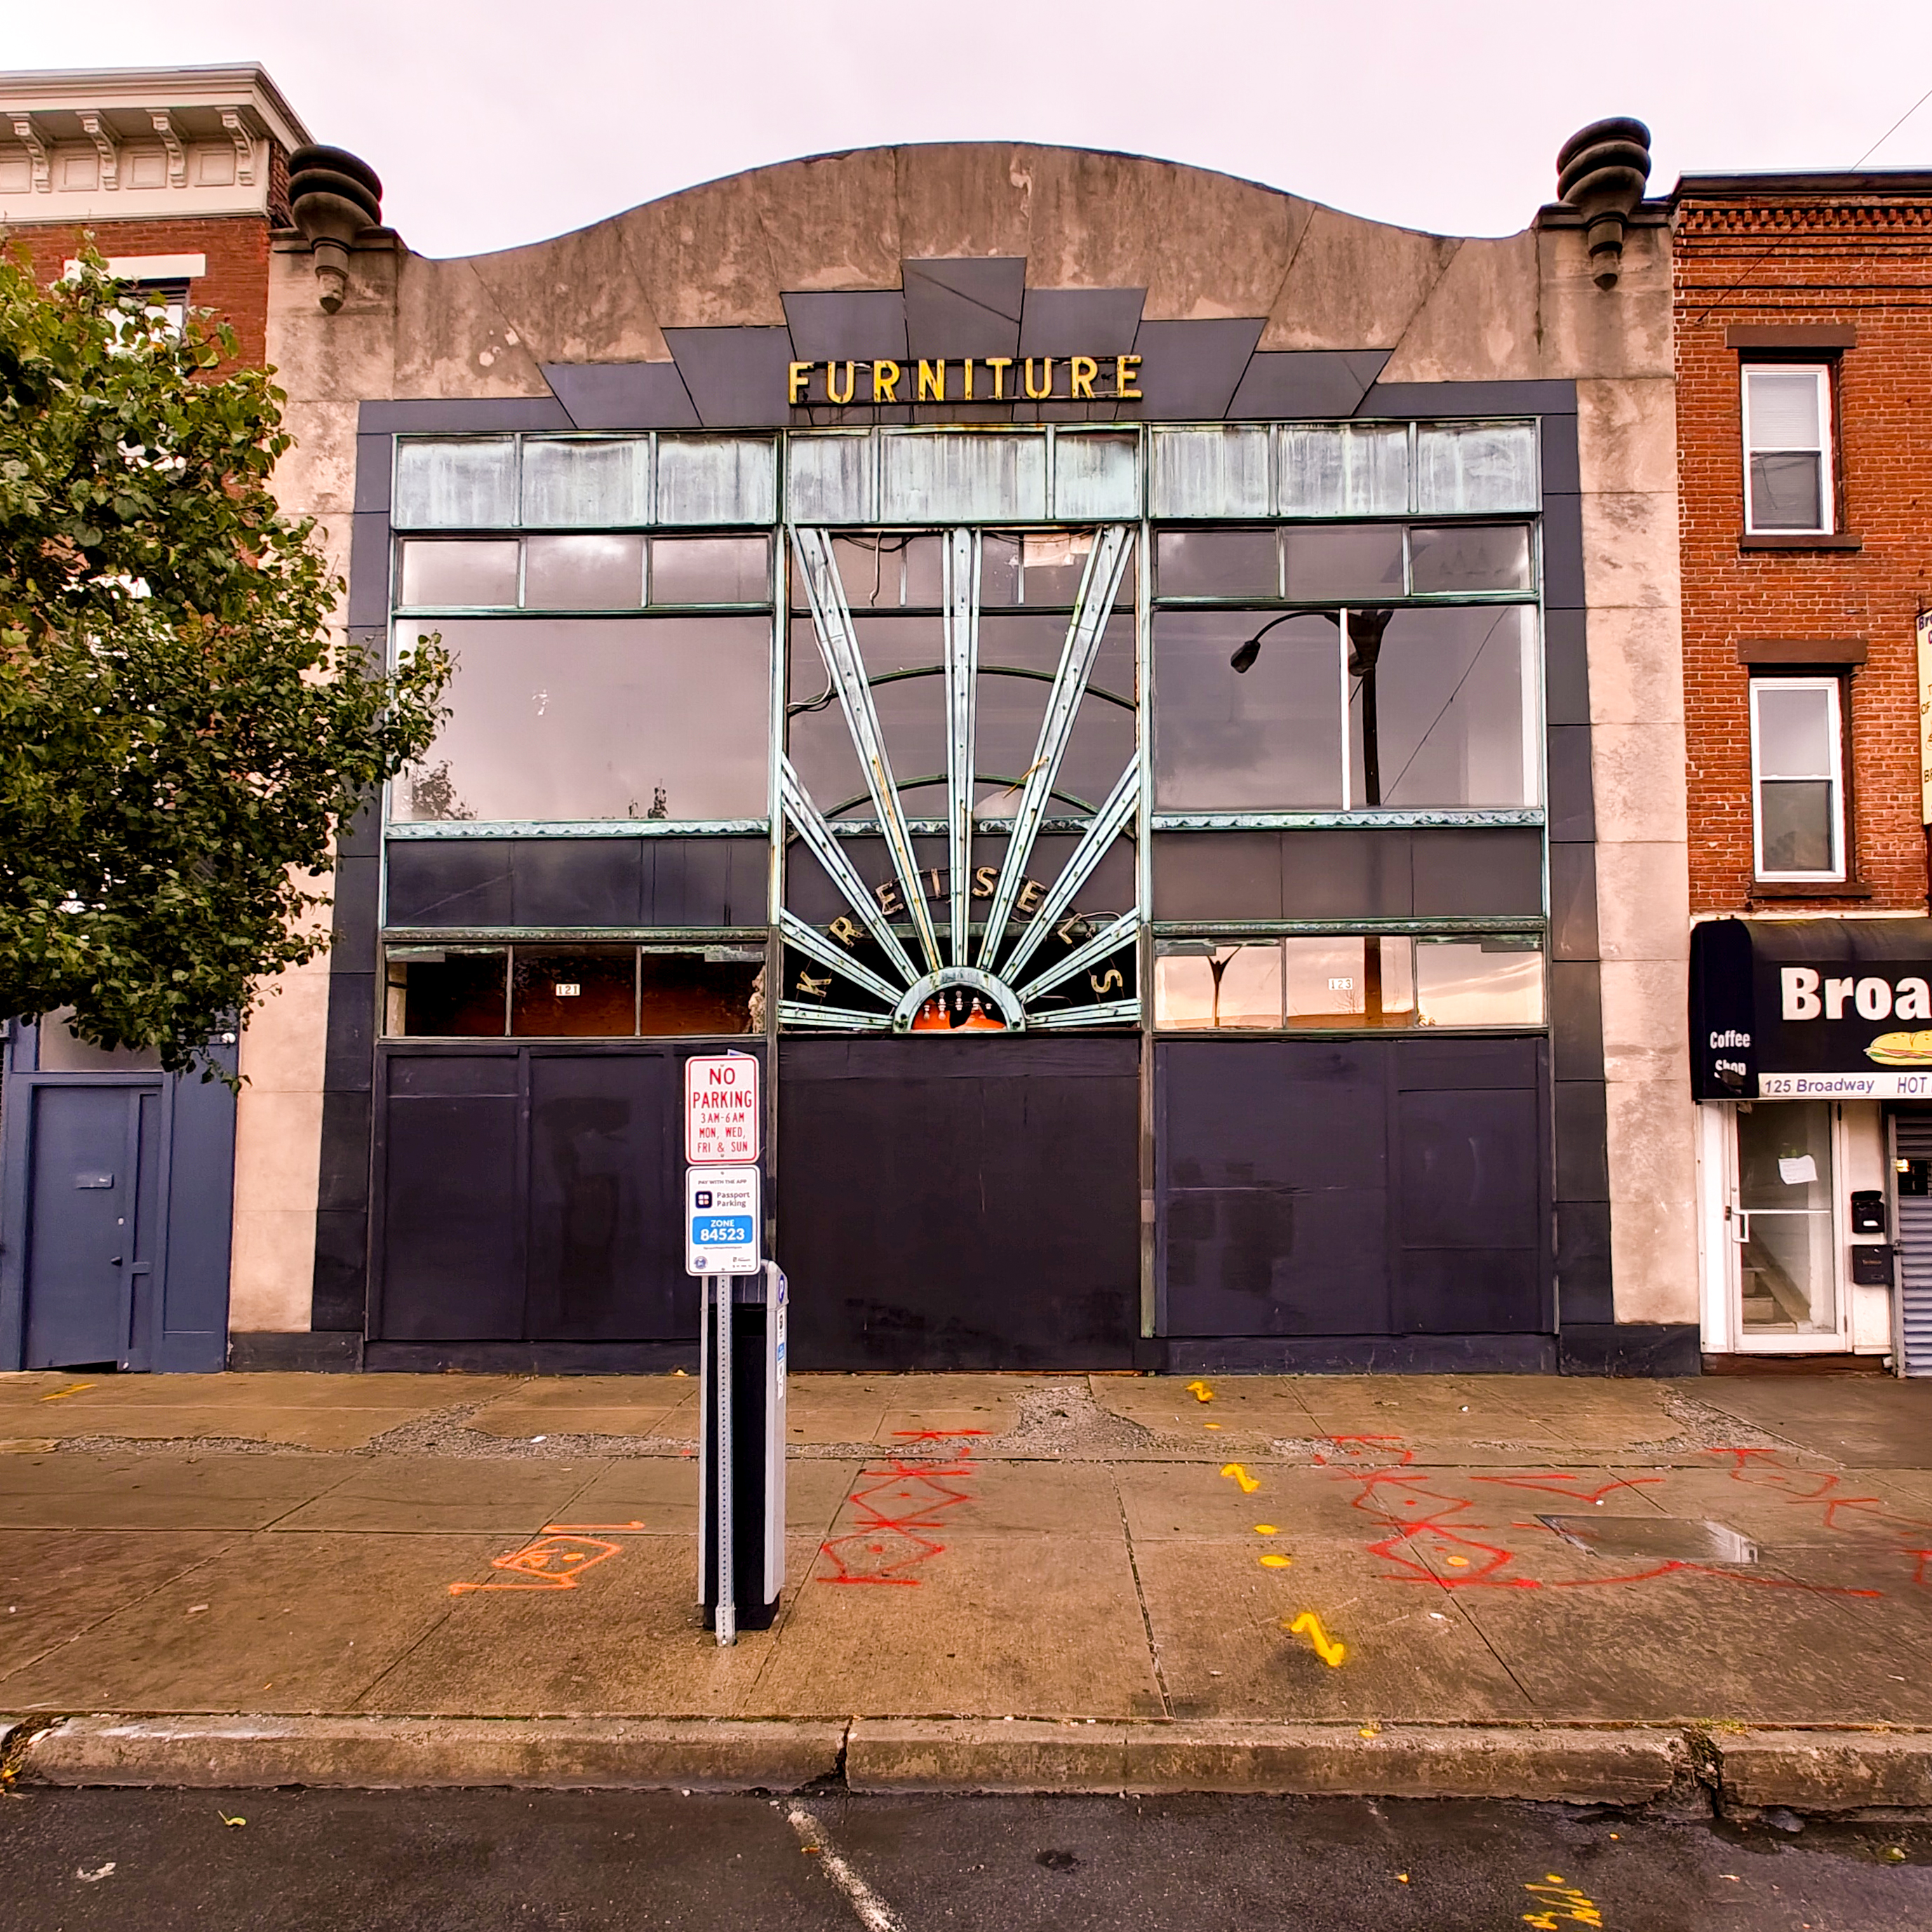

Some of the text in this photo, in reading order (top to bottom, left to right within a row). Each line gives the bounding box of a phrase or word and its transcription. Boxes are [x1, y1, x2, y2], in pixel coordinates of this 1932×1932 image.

[789, 355, 1143, 404] FURNITURE
[558, 985, 577, 995] 121
[1331, 979, 1351, 989] 123
[1780, 967, 1932, 1021] Broa
[1710, 1029, 1751, 1049] Coffee
[709, 1067, 736, 1085] NO
[1764, 1077, 1928, 1094] 125 Broadway HOT
[692, 1090, 753, 1109] PARKING
[699, 1127, 746, 1139] MON, WED,
[697, 1141, 749, 1153] FRI & SUN
[717, 1200, 746, 1208] Parking
[710, 1219, 735, 1228] ZONE
[700, 1228, 745, 1242] 84523
